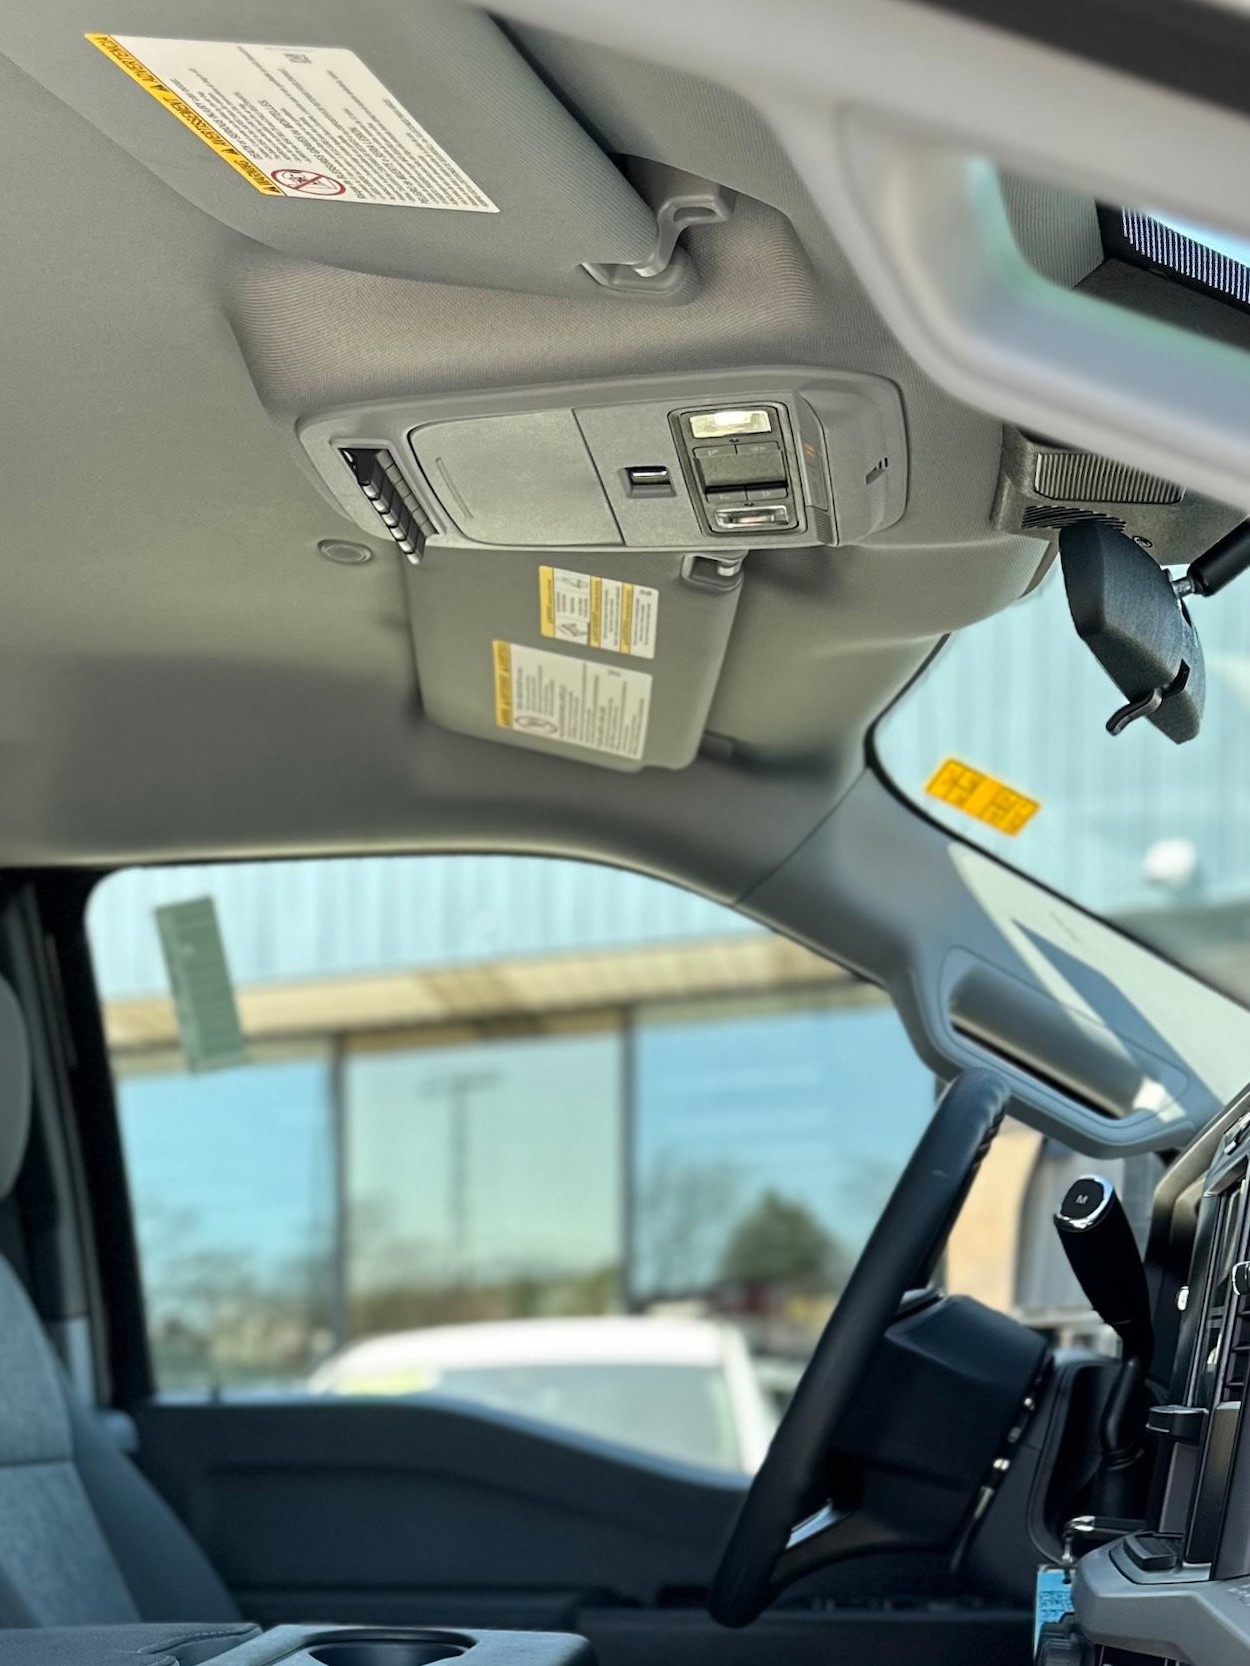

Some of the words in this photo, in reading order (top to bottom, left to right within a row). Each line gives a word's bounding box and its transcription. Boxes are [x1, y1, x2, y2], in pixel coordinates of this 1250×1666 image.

[92, 36, 158, 82] ADVERTENCIA
[161, 96, 229, 146] AVERTISSEMENT
[231, 159, 272, 185] WARNING
